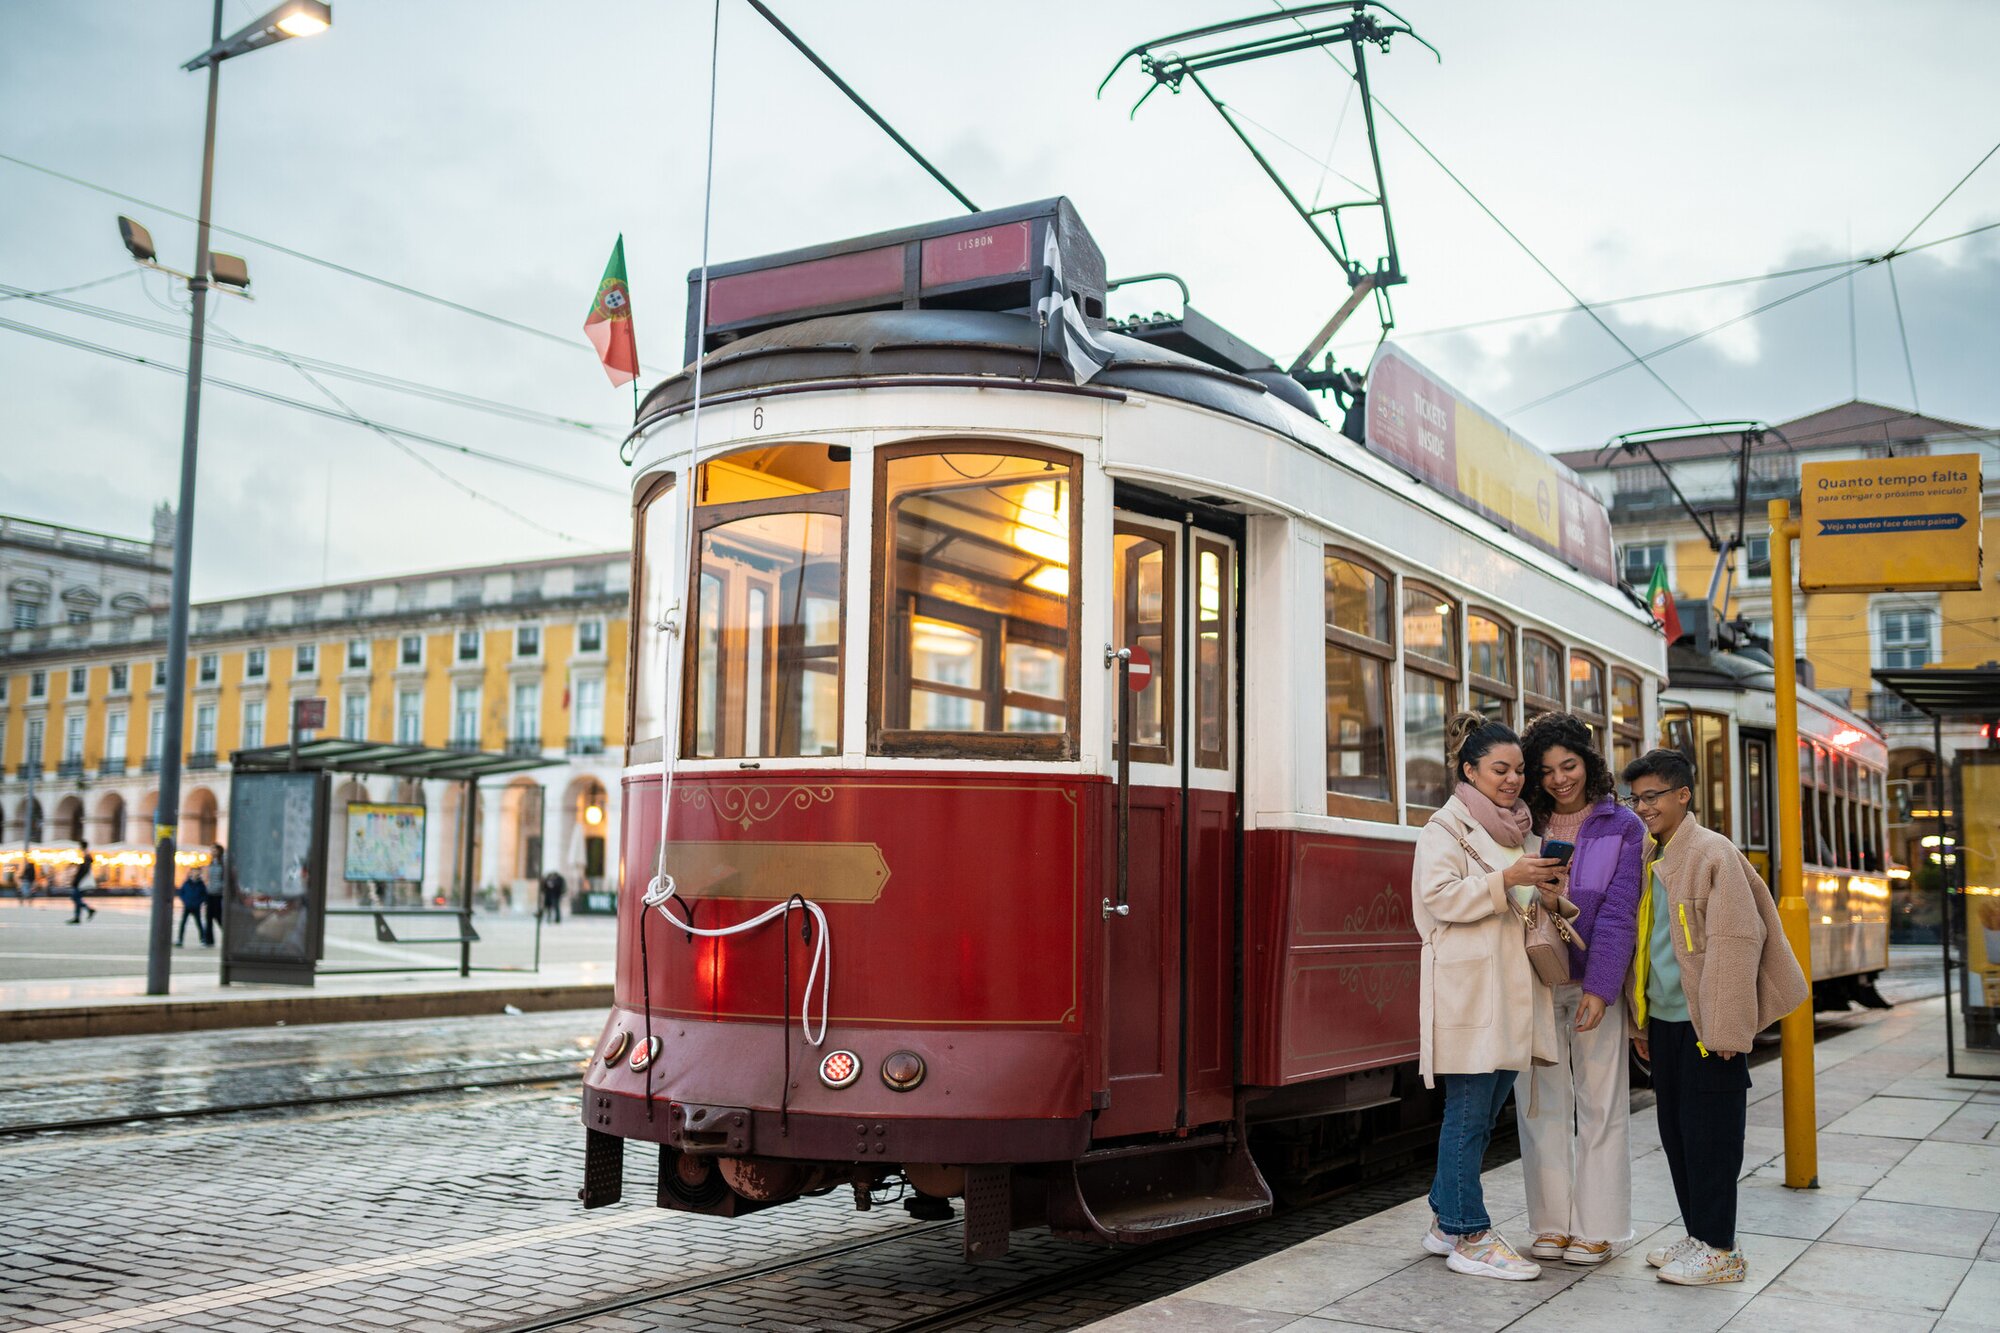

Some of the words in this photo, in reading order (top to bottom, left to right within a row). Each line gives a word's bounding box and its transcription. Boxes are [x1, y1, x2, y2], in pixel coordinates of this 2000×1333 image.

[958, 236, 993, 251] LISBON
[753, 406, 764, 431] 6
[1413, 391, 1448, 432] TICKETS
[1416, 425, 1447, 461] INSIDE
[1817, 477, 1873, 491] Quanto
[1878, 473, 1927, 487] tempo
[1932, 470, 1968, 483] falta
[1817, 494, 1839, 503] para
[1826, 523, 1844, 531] Veja
[1858, 520, 1881, 529] outra
[1883, 519, 1900, 528] face
[1903, 519, 1926, 527] deste
